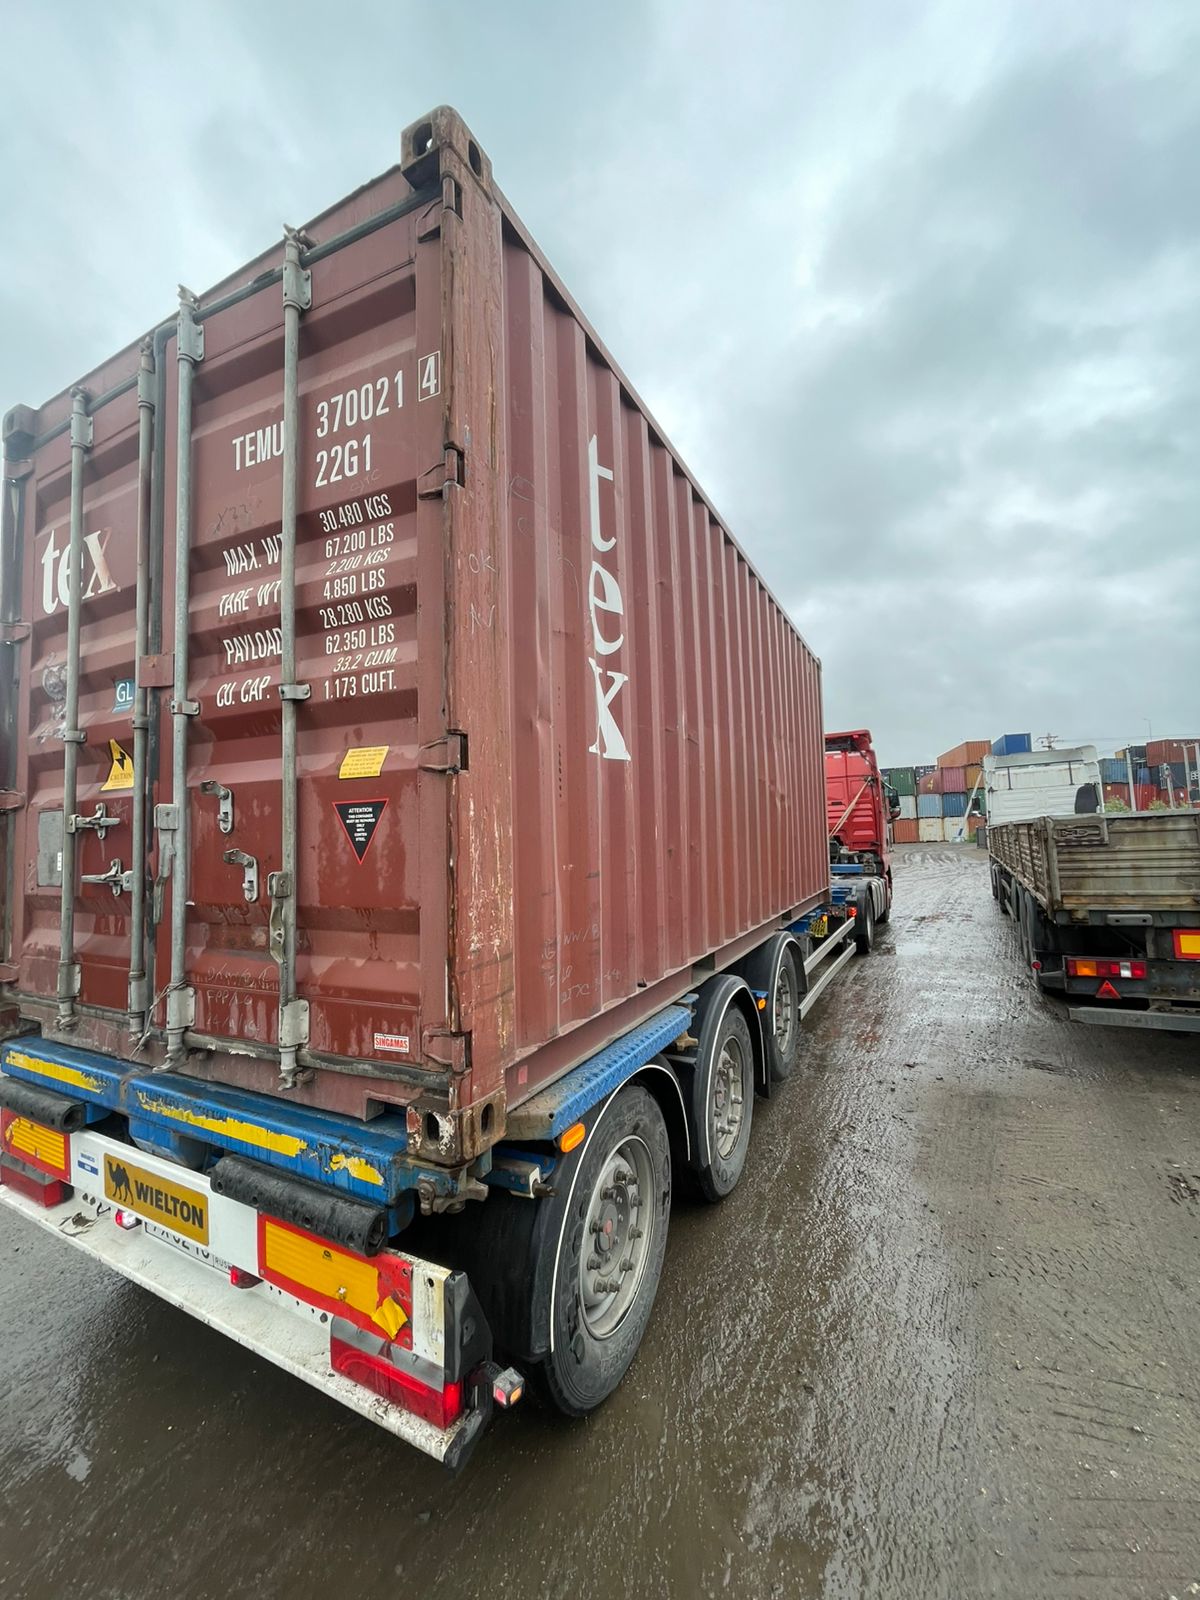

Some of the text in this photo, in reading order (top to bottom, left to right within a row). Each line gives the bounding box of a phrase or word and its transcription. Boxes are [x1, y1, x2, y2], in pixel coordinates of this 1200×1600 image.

[232, 356, 437, 471] TEMU 370021 4
[315, 434, 371, 487] 22G1
[223, 543, 262, 576] MAX.
[319, 502, 363, 533] 30.480
[364, 493, 392, 520] KGS
[325, 523, 394, 558] 67.200 LBS
[219, 587, 254, 617] TARE
[325, 554, 362, 576] 2.200
[364, 547, 391, 567] KGS
[323, 569, 385, 600] 4.850 LBS
[588, 434, 631, 761] tex
[319, 604, 363, 629] 28.280
[365, 596, 392, 620] KGS
[325, 623, 395, 655] 62.350 LBS
[333, 656, 362, 673] 33.2
[116, 682, 133, 702] GL
[216, 681, 236, 708] CU.
[240, 675, 272, 703] CAP.
[324, 676, 356, 700] 1.173
[375, 1037, 408, 1048] SINGAMAS
[134, 1179, 204, 1229] WIELTON
